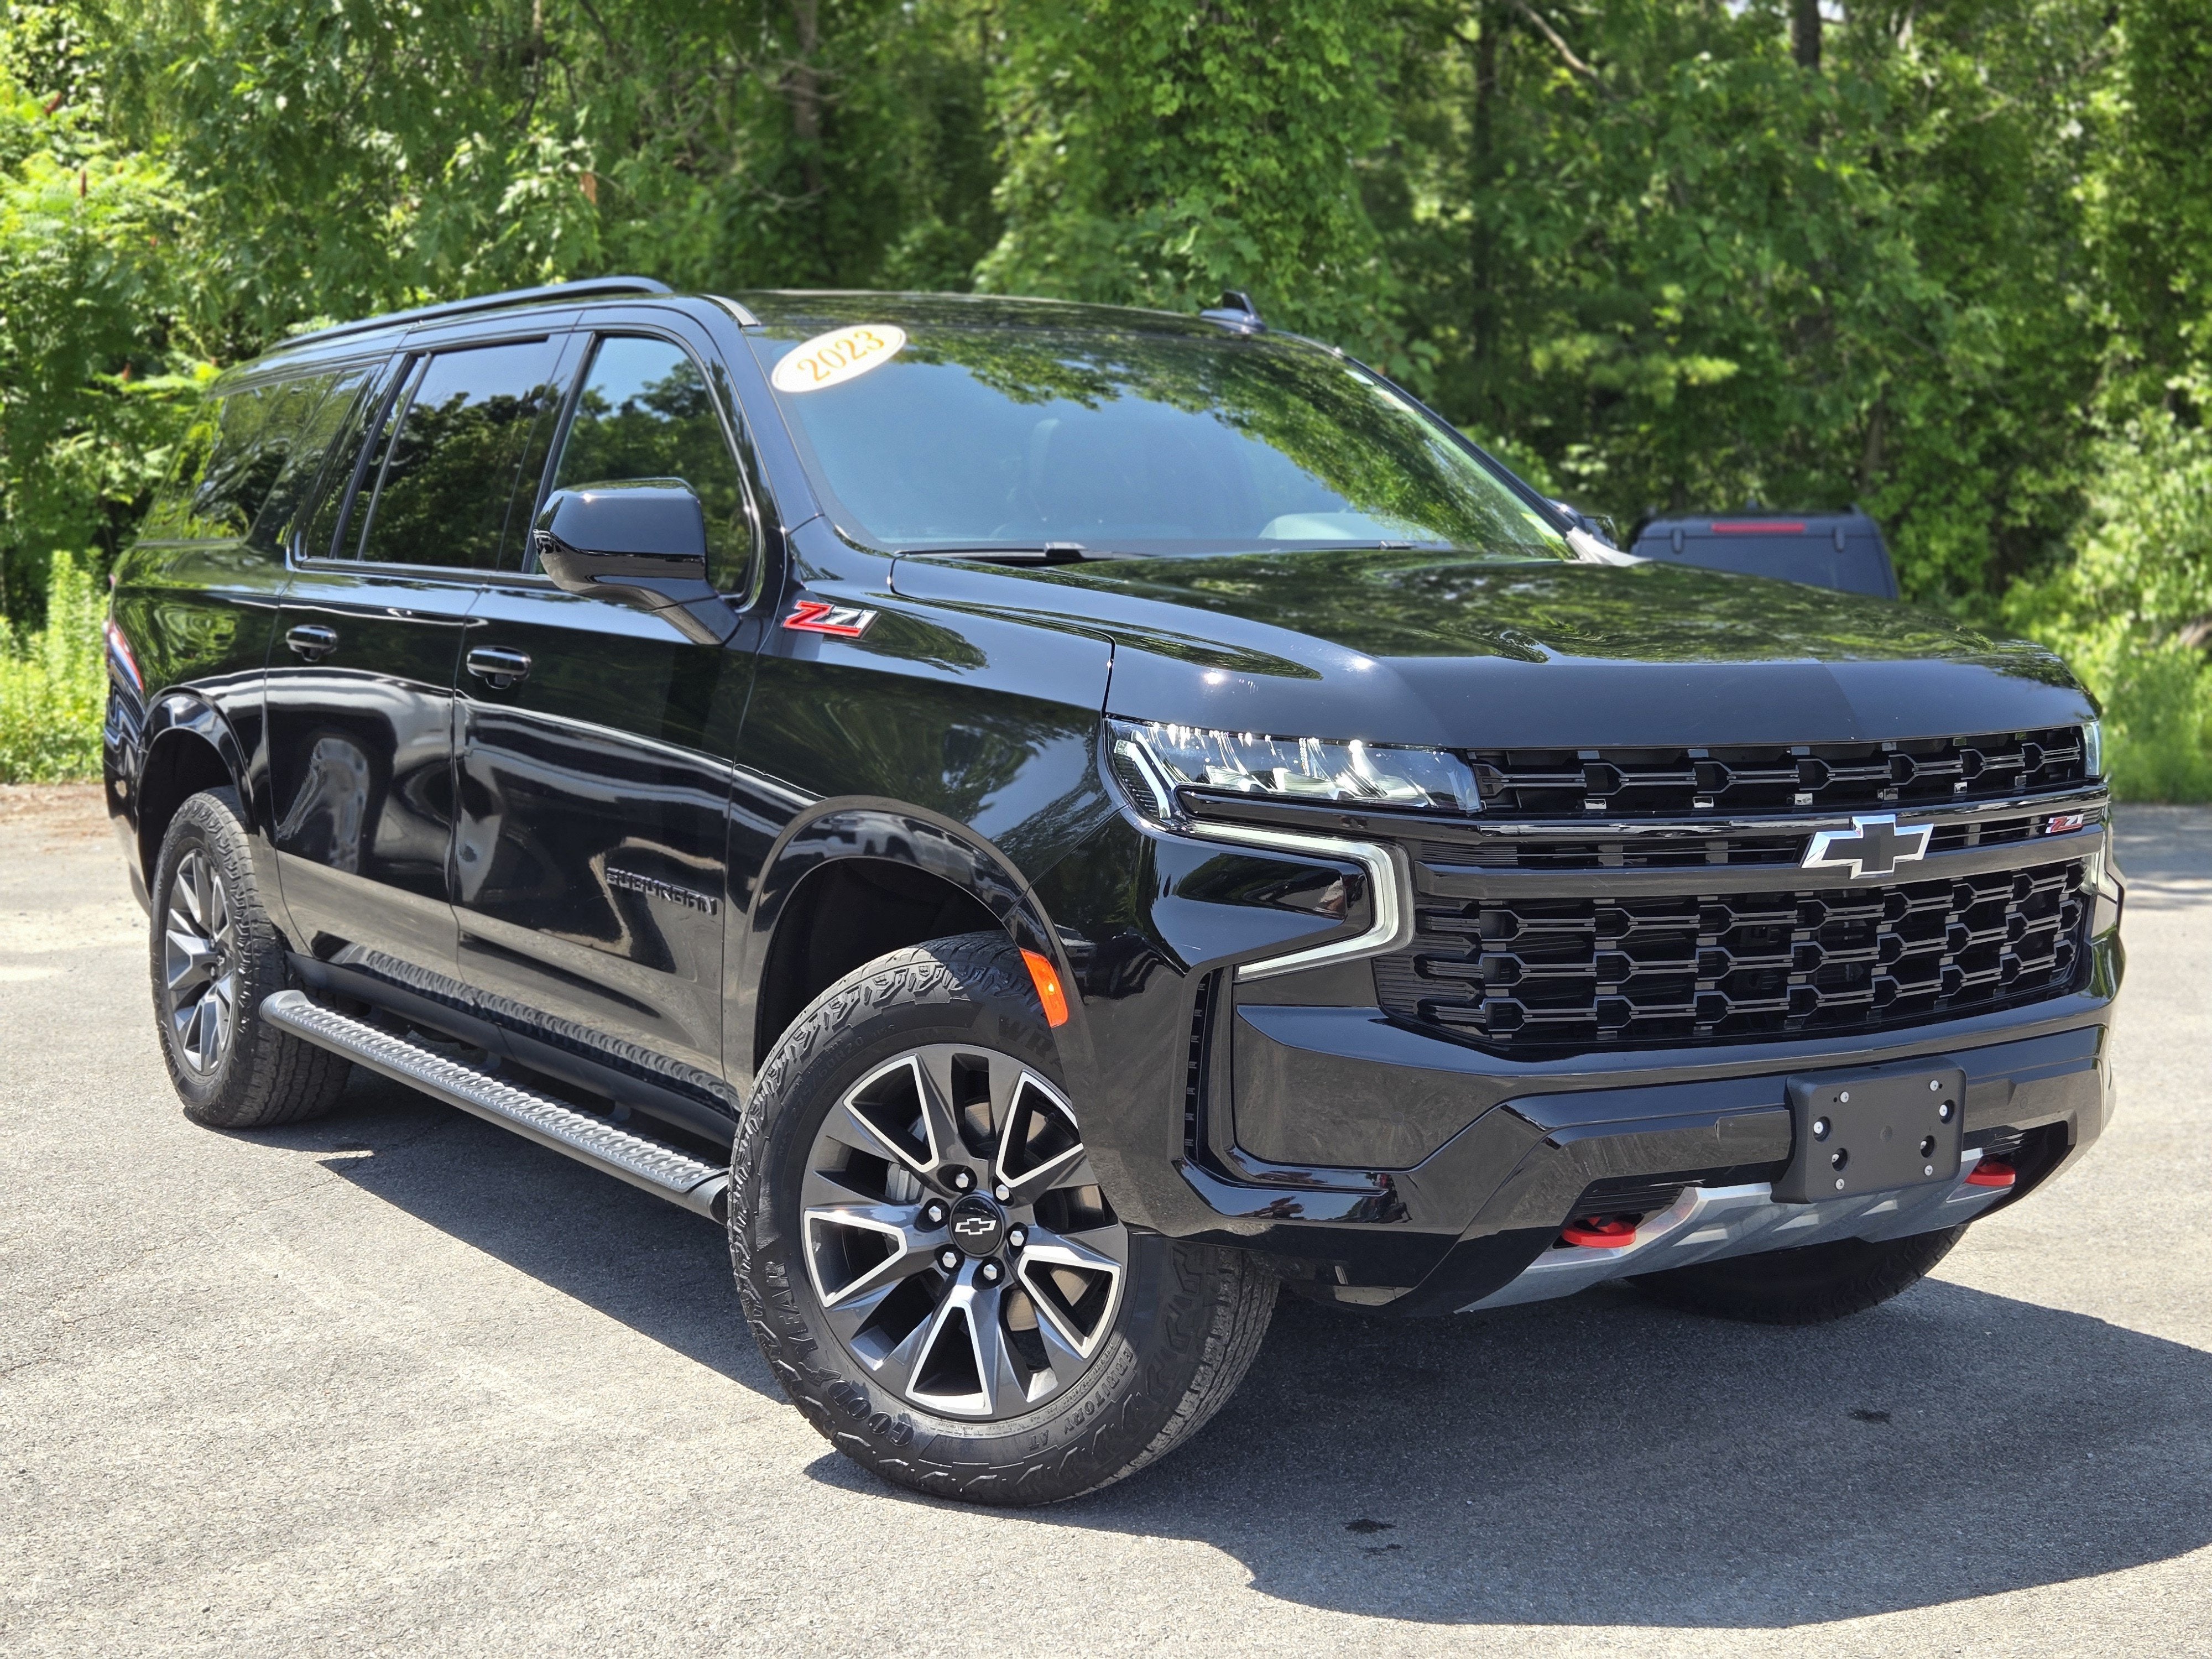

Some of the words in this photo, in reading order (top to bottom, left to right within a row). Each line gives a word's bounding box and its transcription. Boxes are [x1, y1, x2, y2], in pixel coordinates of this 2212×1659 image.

[797, 331, 884, 382] 2023
[781, 599, 878, 638] Z71
[2045, 814, 2084, 833] Z71
[607, 867, 717, 915] SUBURBAN
[1029, 1429, 1049, 1451] AT
